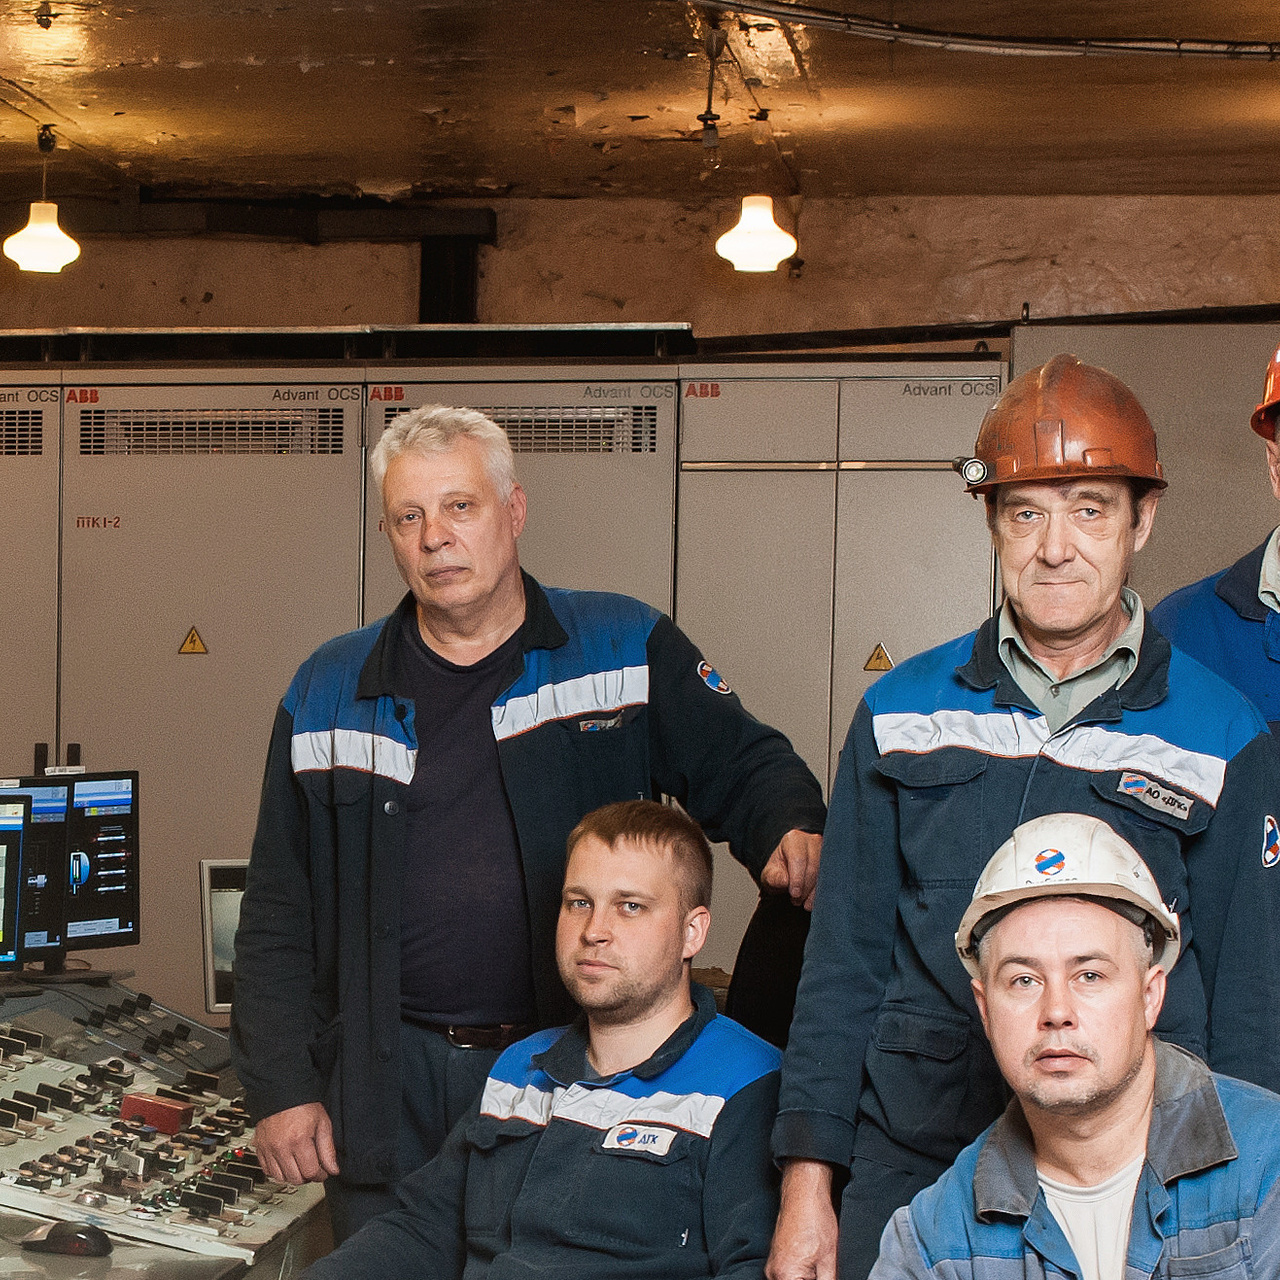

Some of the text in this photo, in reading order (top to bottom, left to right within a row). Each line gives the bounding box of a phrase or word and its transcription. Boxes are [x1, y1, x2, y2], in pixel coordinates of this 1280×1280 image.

[26, 389, 60, 403] OCS
[65, 389, 100, 403] ABB
[272, 387, 360, 401] Advant OCS
[370, 386, 405, 401] ABB
[582, 385, 674, 399] Advant OCS
[684, 383, 721, 398] ABB
[902, 382, 996, 396] Advant OCS
